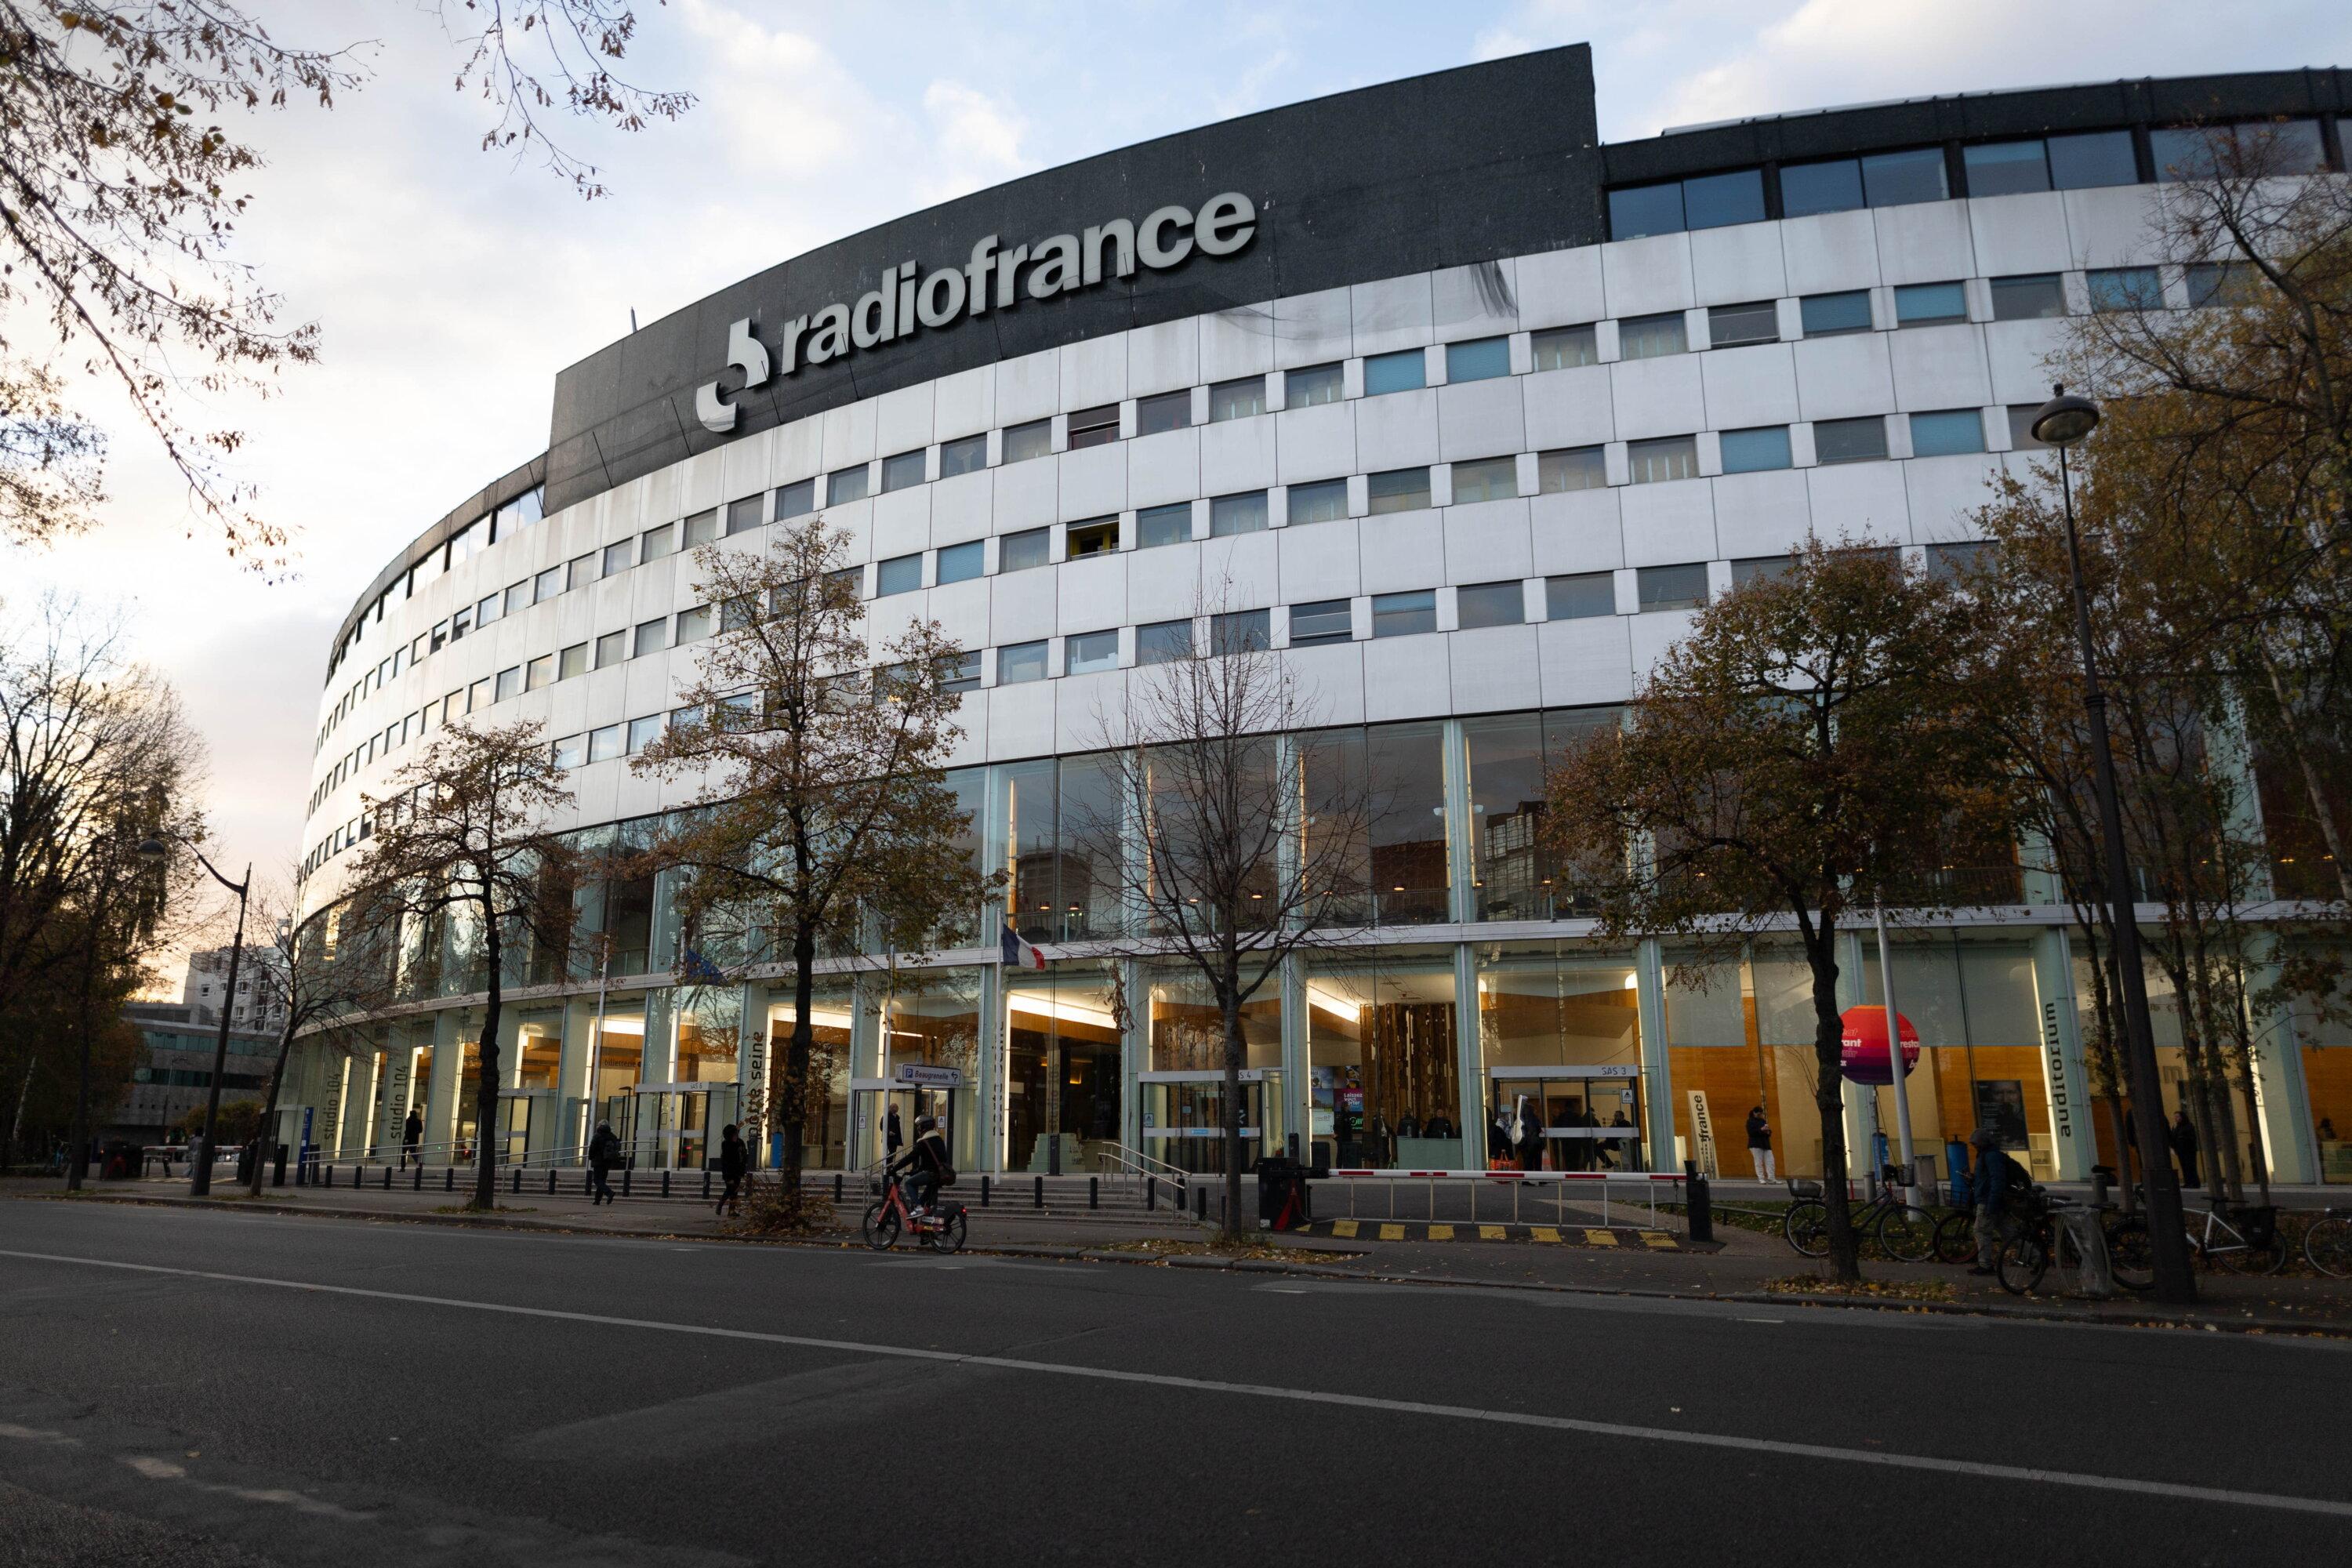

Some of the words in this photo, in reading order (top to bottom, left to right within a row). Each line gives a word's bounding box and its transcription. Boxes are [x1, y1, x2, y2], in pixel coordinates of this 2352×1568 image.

[781, 191, 1256, 376] radiofrance
[394, 1065, 409, 1088] 104
[748, 1031, 764, 1080] seine
[915, 1070, 949, 1080] Beaugrenelle
[2045, 1003, 2071, 1138] auditorium
[326, 1073, 341, 1094] 104
[323, 1099, 338, 1140] studio
[390, 1094, 405, 1139] studio
